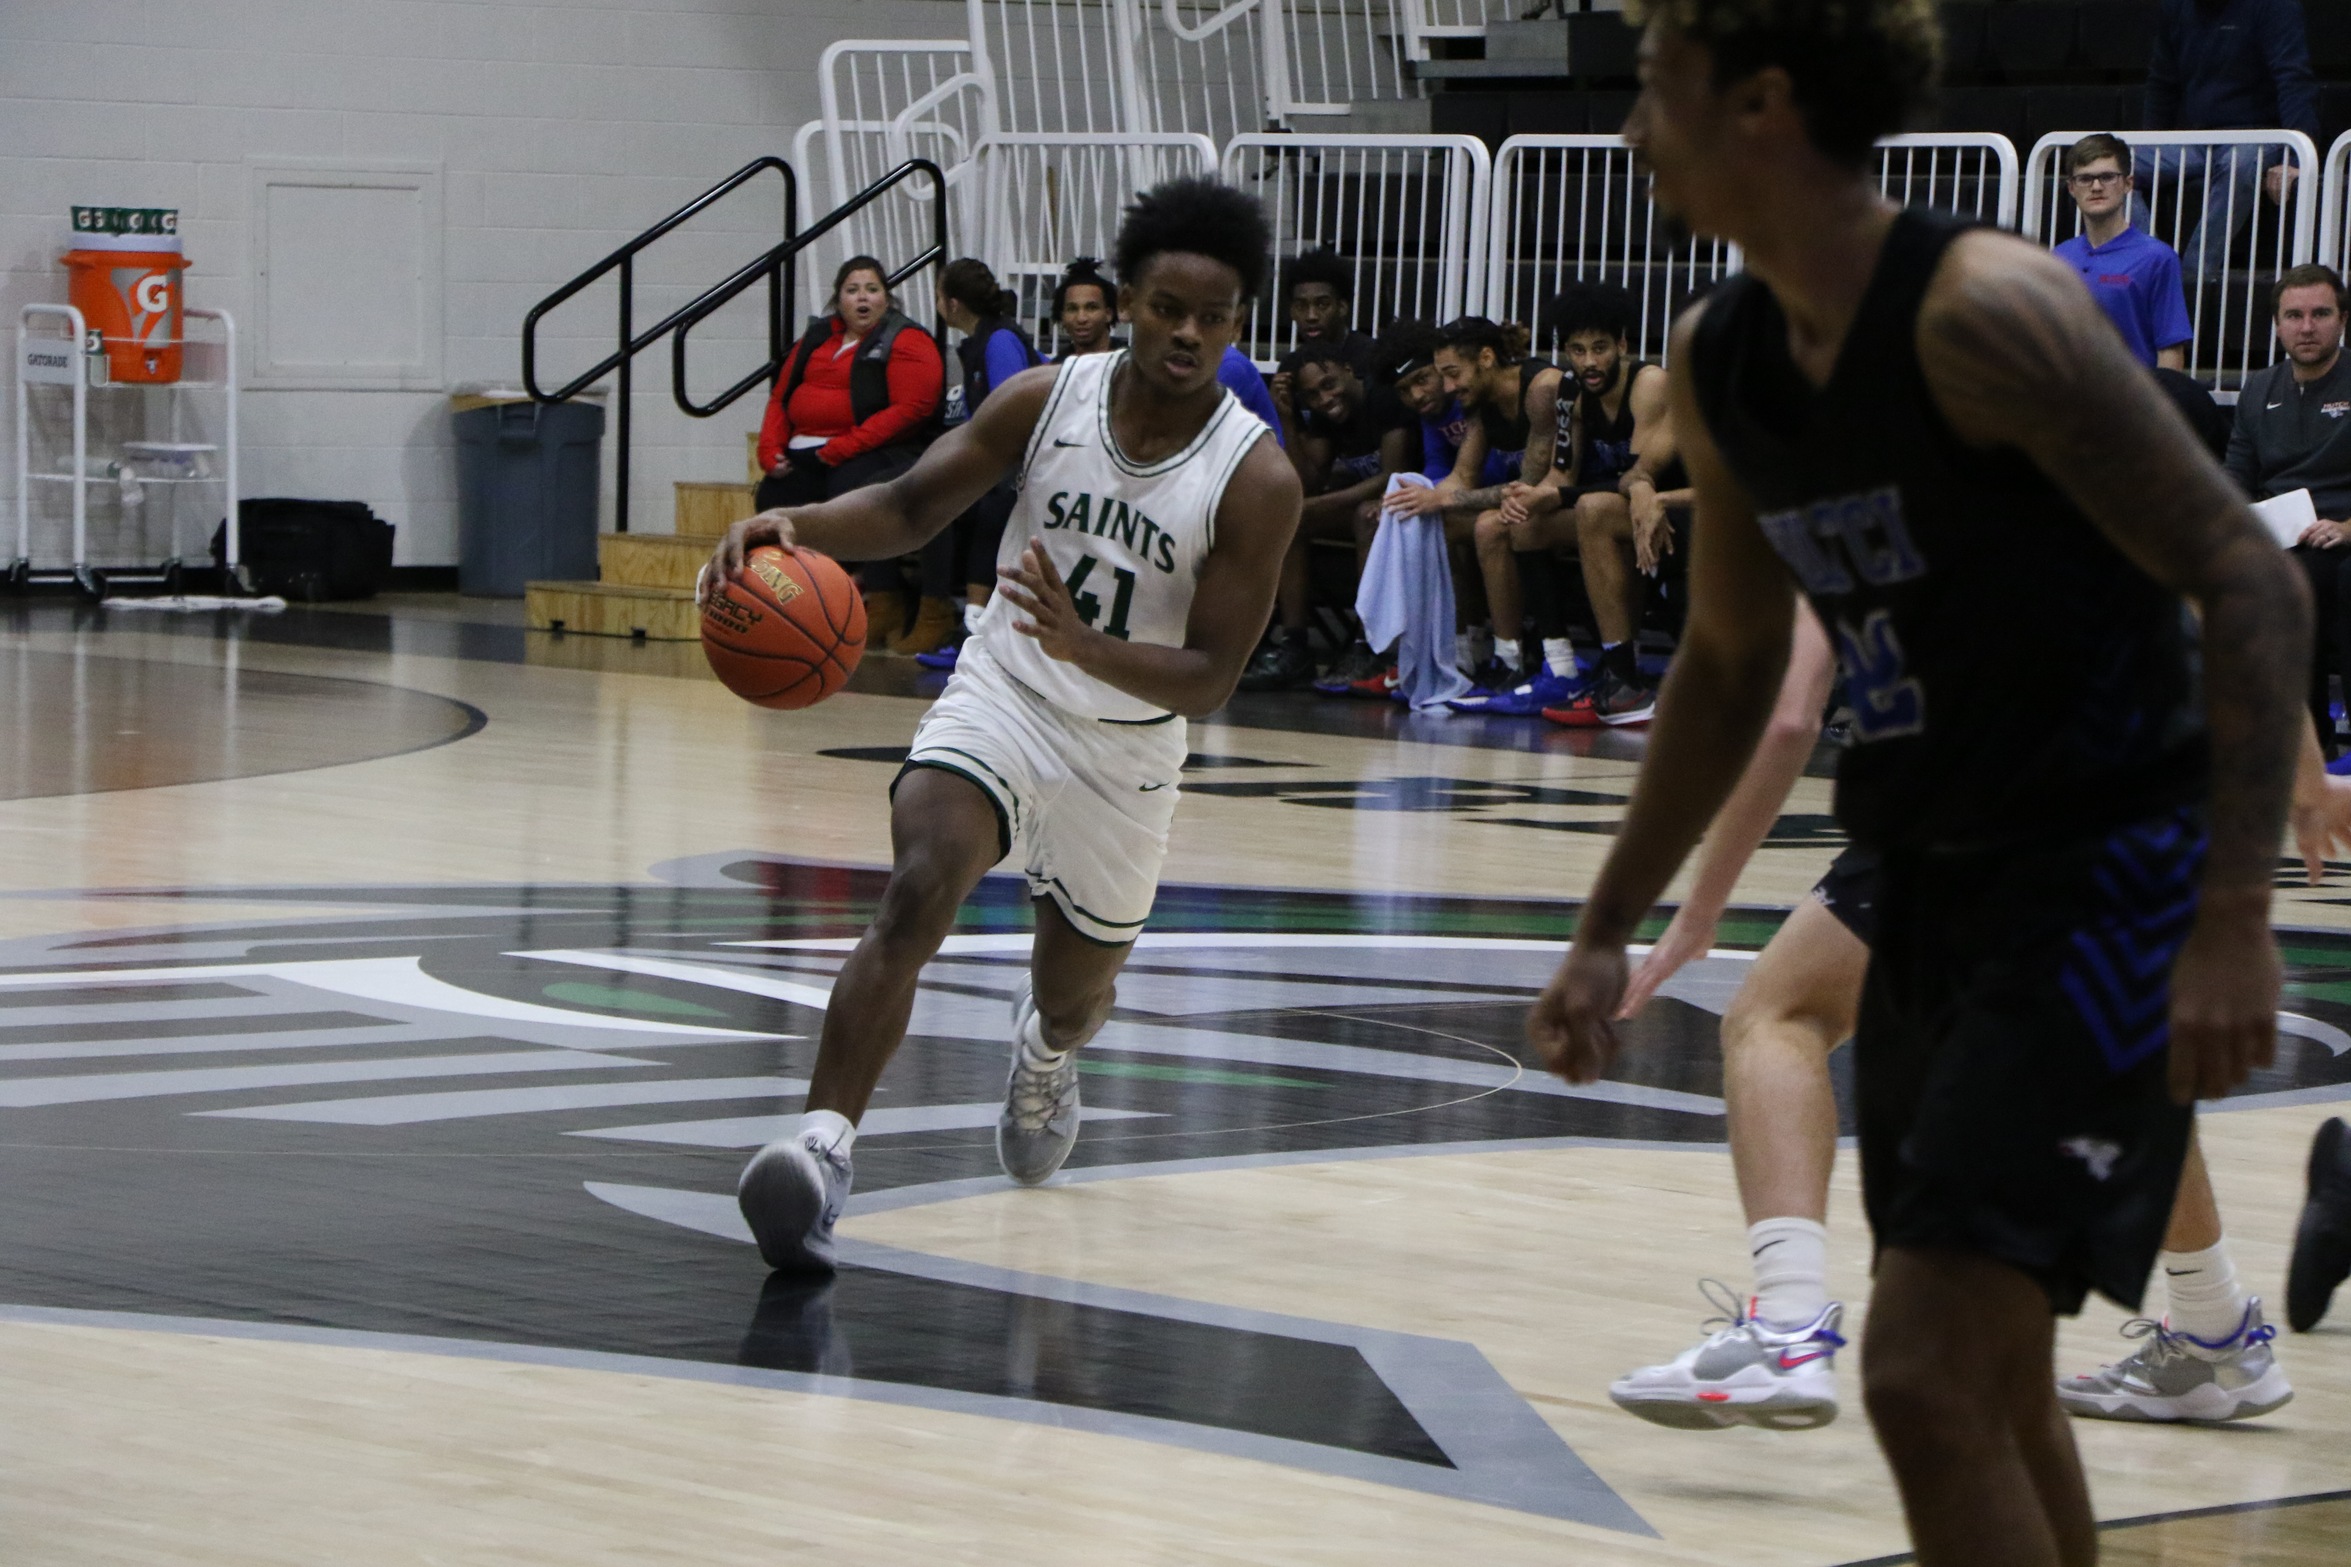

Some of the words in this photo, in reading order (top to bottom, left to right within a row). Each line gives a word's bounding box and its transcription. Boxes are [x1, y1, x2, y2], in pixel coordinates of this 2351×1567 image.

[137, 275, 168, 313] G
[1043, 491, 1176, 574] SAINTS
[1065, 553, 1136, 641] 41
